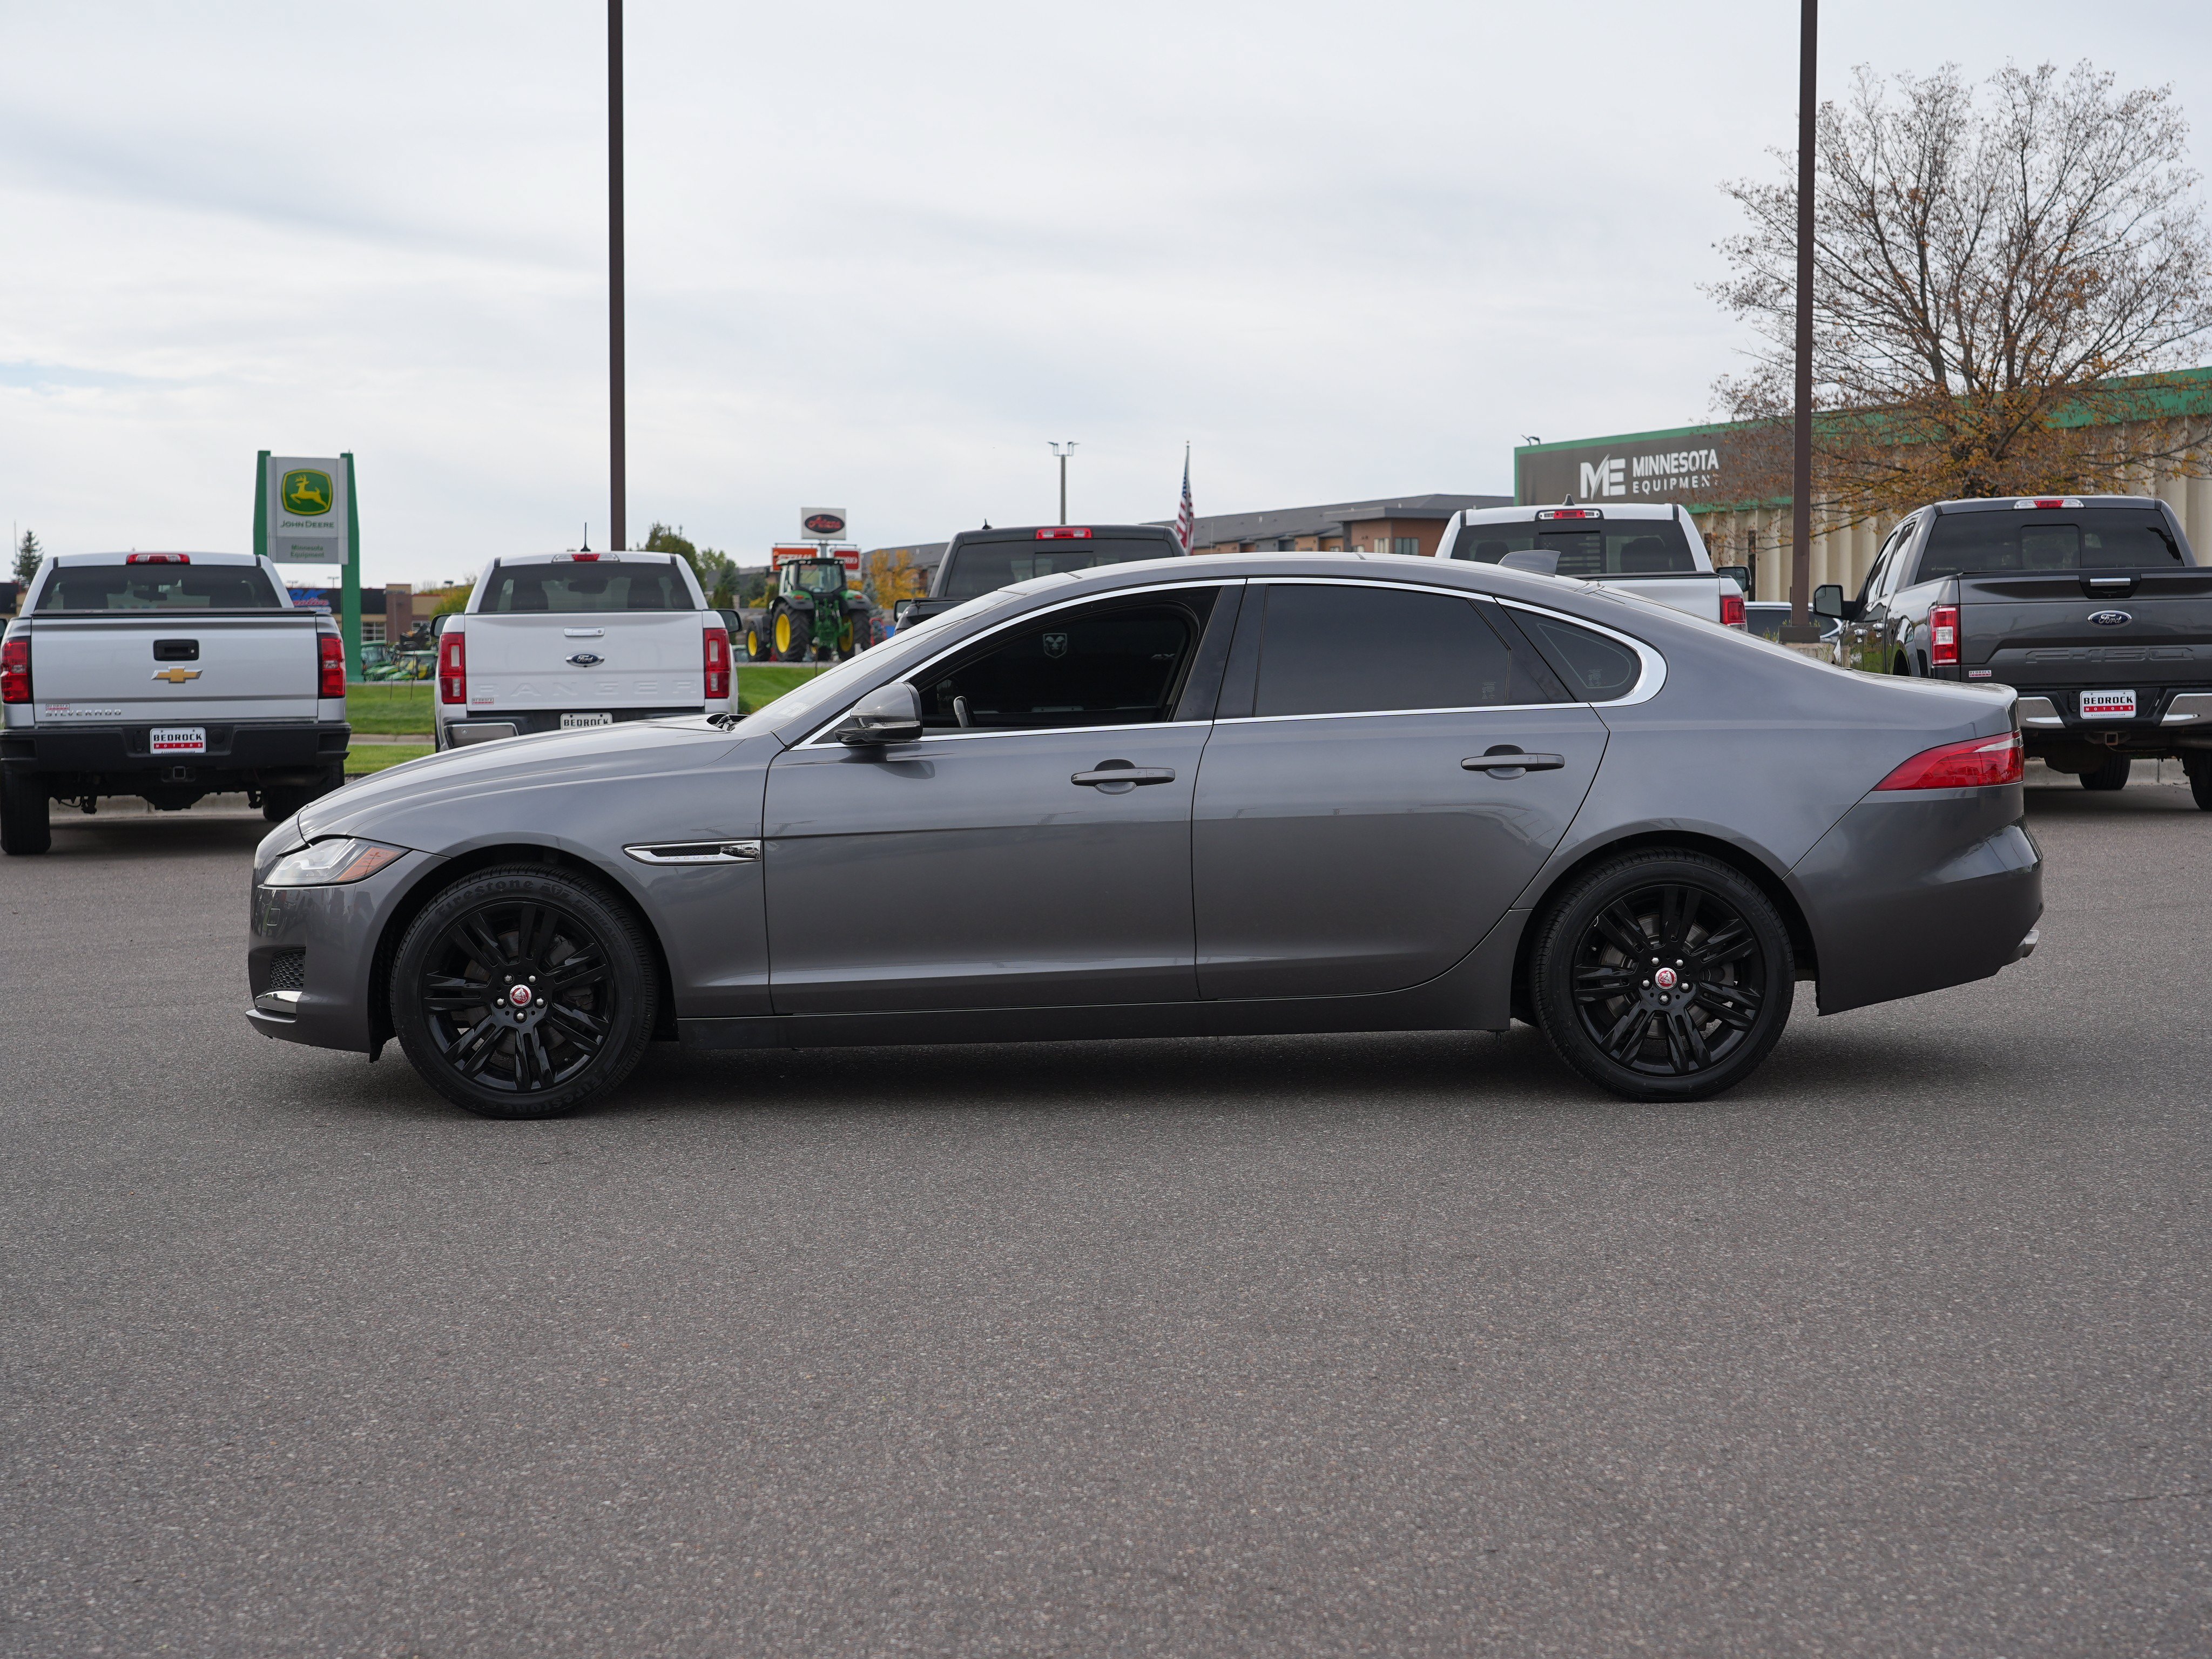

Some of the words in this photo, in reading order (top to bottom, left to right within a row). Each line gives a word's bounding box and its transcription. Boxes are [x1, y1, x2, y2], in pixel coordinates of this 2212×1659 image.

[1632, 448, 1719, 477] MINNESOTA
[1580, 453, 1626, 501] ME
[280, 520, 304, 528] JOHN
[306, 520, 335, 529] DEERE
[290, 551, 325, 559] Equipment
[2098, 613, 2122, 624] Ford
[576, 655, 594, 663] Ford
[2026, 648, 2194, 664] F-150
[2083, 696, 2133, 705] BEDROCK
[45, 709, 122, 717] SILVERADO
[564, 718, 609, 727] BEDROCK
[154, 733, 203, 741] BEDROCK
[434, 880, 534, 919] Firestone
[502, 1069, 605, 1115] Firestone
